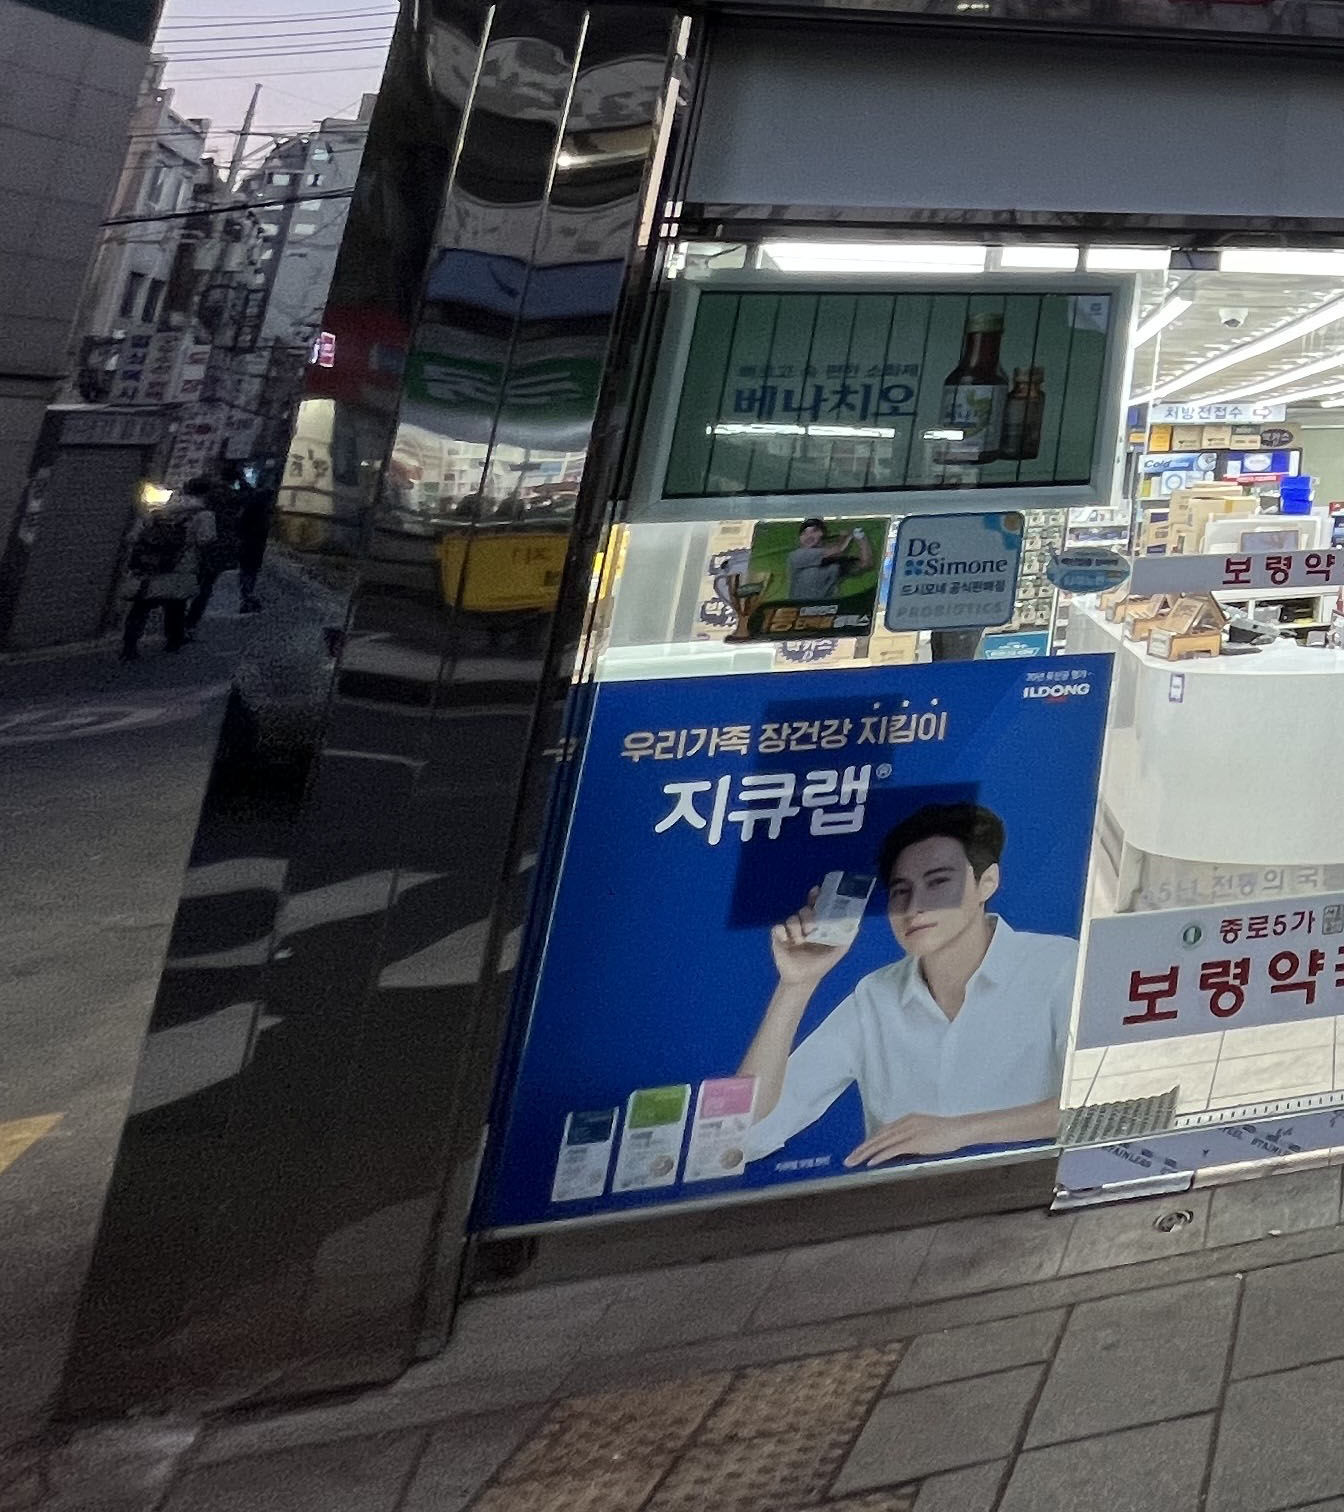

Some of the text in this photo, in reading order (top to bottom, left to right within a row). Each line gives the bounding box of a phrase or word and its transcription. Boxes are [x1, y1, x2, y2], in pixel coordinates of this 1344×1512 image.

[733, 383, 918, 422] 베나치오
[1164, 405, 1244, 421] 처방전접수
[1144, 458, 1171, 470] Cold
[907, 538, 941, 557] De
[923, 557, 1008, 577] Simone
[1023, 683, 1091, 699] ILDONG
[621, 710, 948, 762] 우리가족 장건강 지킴이
[1219, 909, 1316, 944] 종로5가
